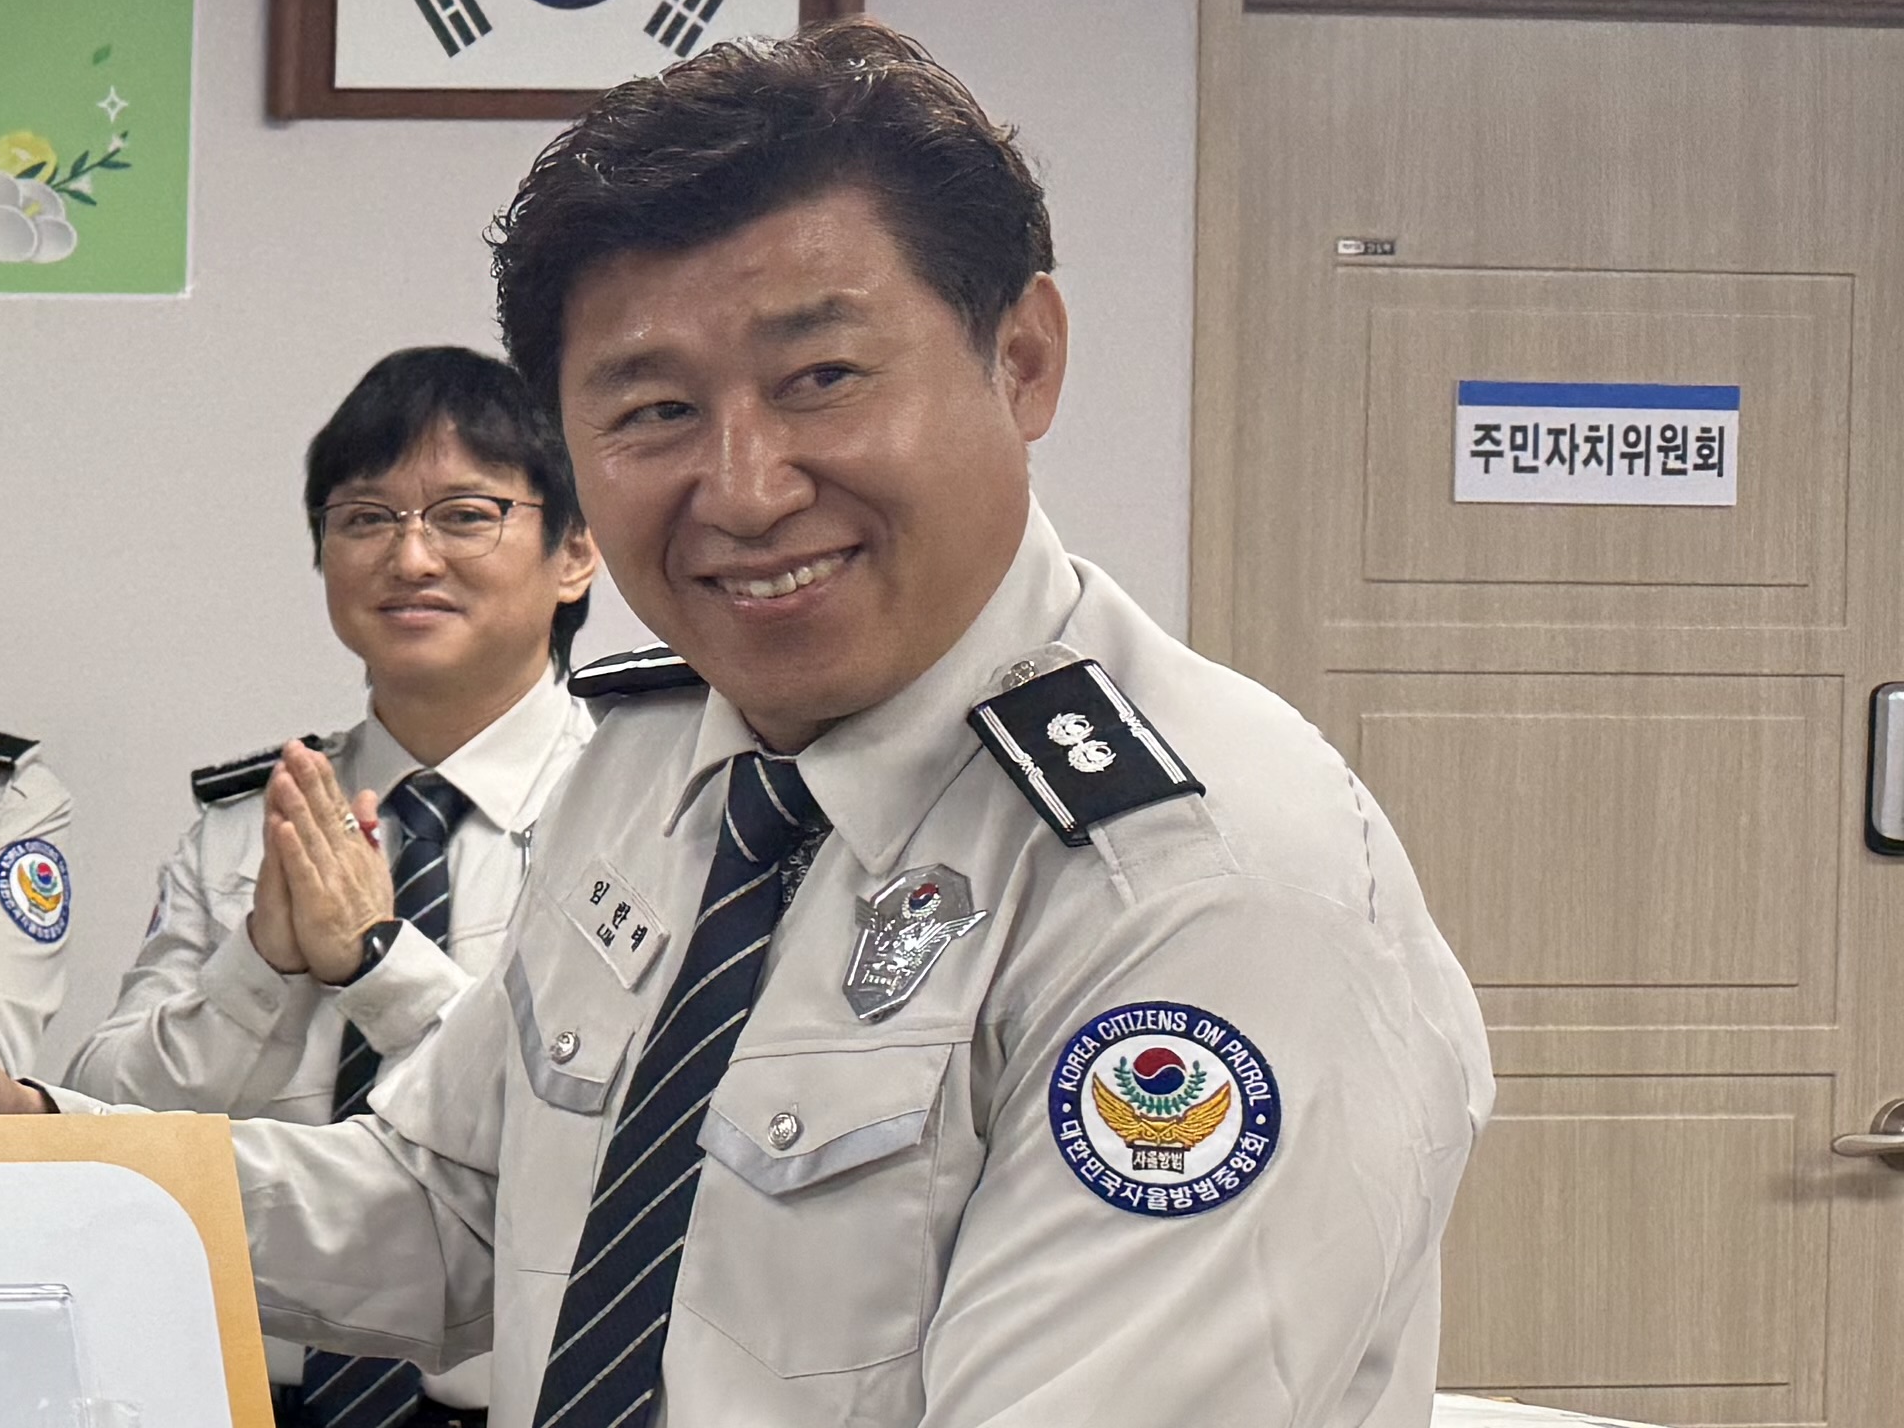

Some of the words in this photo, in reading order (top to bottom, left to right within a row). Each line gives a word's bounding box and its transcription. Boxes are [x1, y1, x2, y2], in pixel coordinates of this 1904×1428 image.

[1469, 421, 1727, 478] 주민자치위원회
[1058, 1035, 1101, 1091] KOREA
[1097, 1010, 1188, 1041] CITIZENS
[1193, 1019, 1226, 1047] ON
[1220, 1039, 1272, 1107] PATROL
